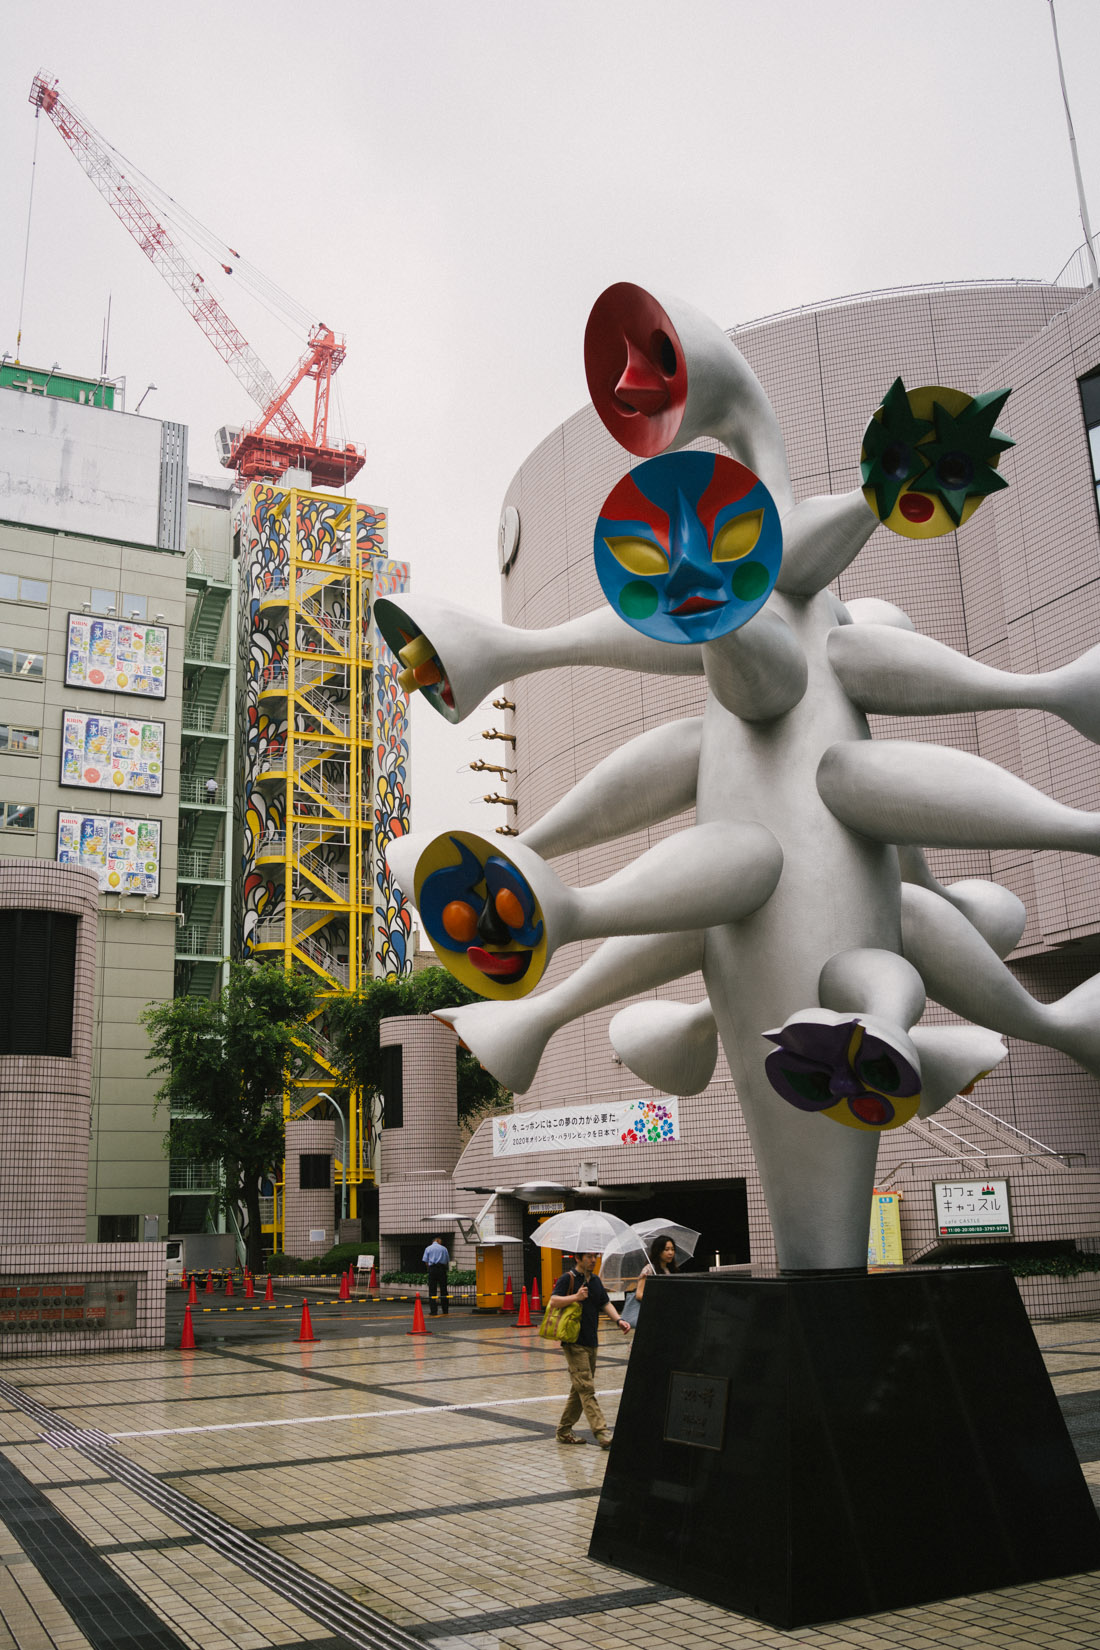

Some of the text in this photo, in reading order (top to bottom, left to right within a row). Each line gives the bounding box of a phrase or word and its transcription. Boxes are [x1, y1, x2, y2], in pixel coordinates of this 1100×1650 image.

[116, 661, 151, 675] 夏の氷結
[112, 758, 148, 773] 夏の氷結
[107, 860, 144, 873] 夏の氷結
[512, 1113, 619, 1133] 今、ニッポンにはこの夢の力が必要だ。
[941, 1185, 974, 1198] カフェ
[943, 1198, 1001, 1213] キャッスル
